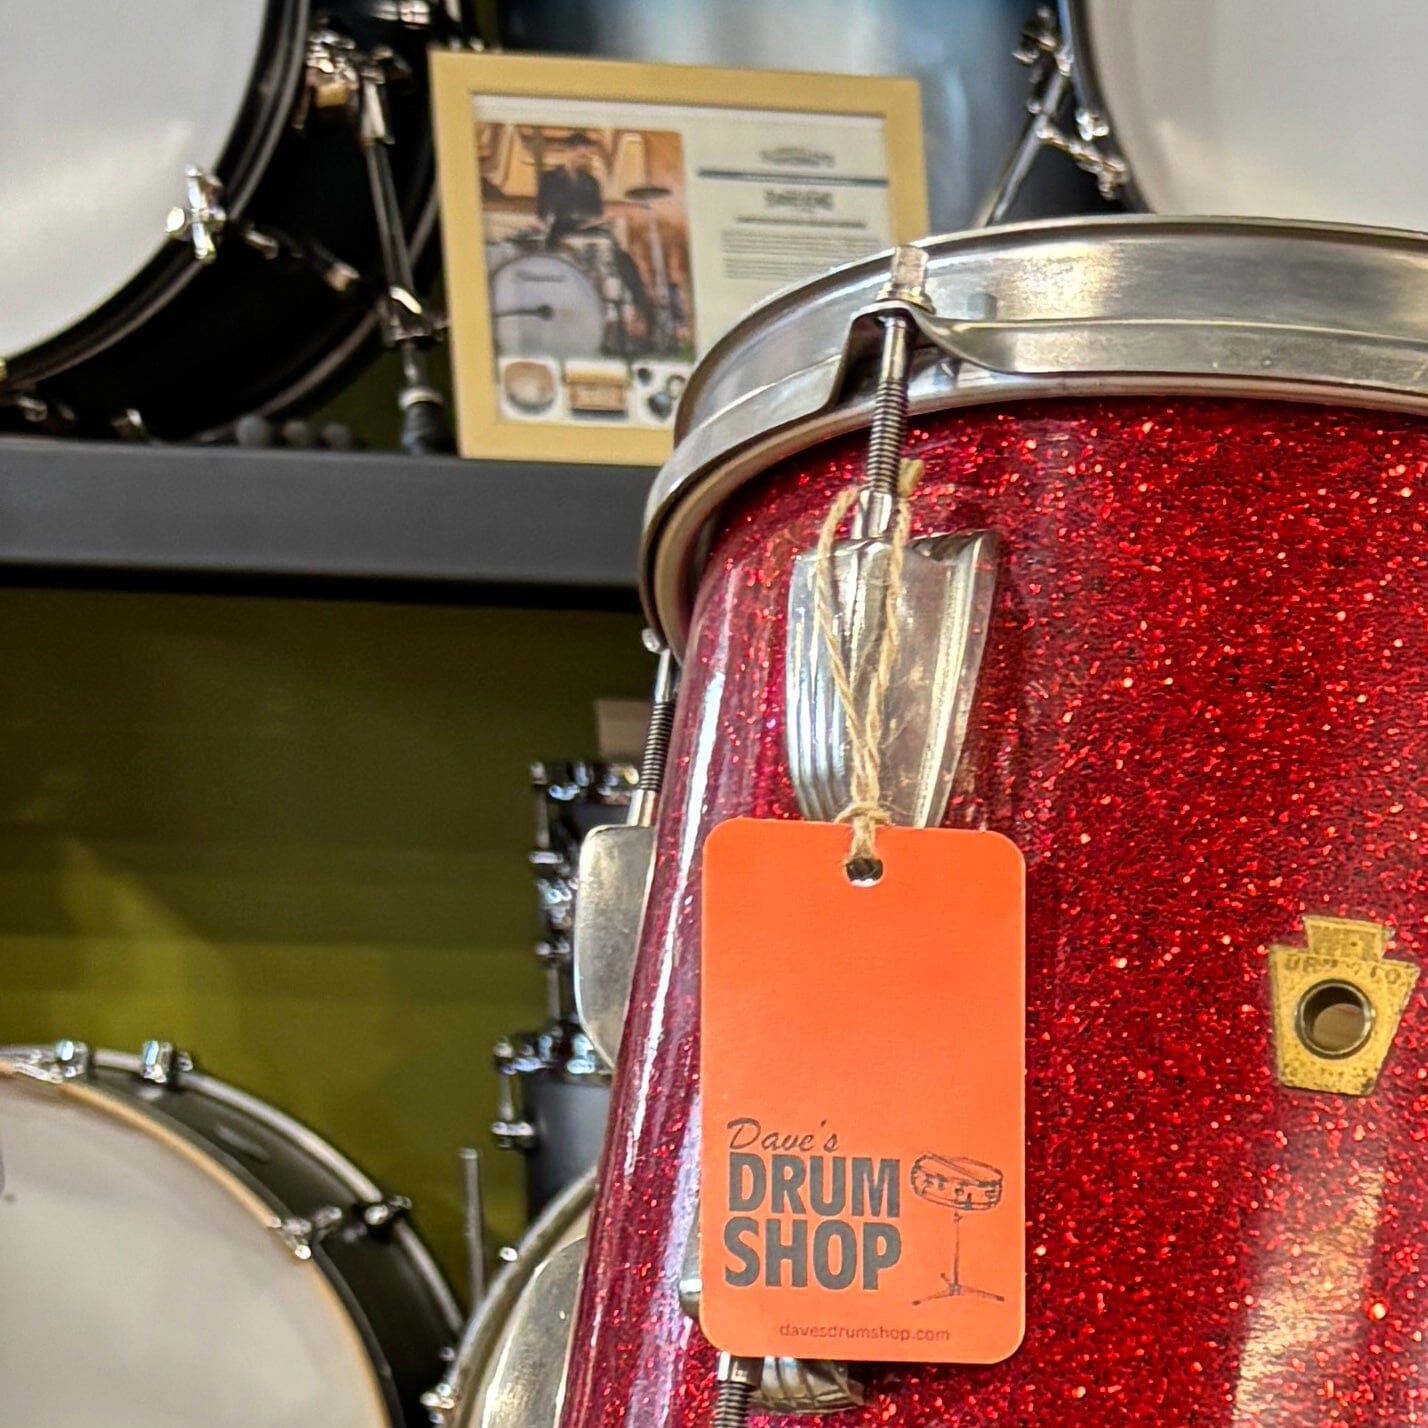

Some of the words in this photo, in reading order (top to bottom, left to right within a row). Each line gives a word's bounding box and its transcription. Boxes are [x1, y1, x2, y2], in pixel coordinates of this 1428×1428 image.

[726, 1117, 840, 1153] Dave's
[728, 1151, 901, 1218] DRUM
[723, 1216, 902, 1291] SHOP
[779, 1322, 951, 1342] davesdrumshop.com
